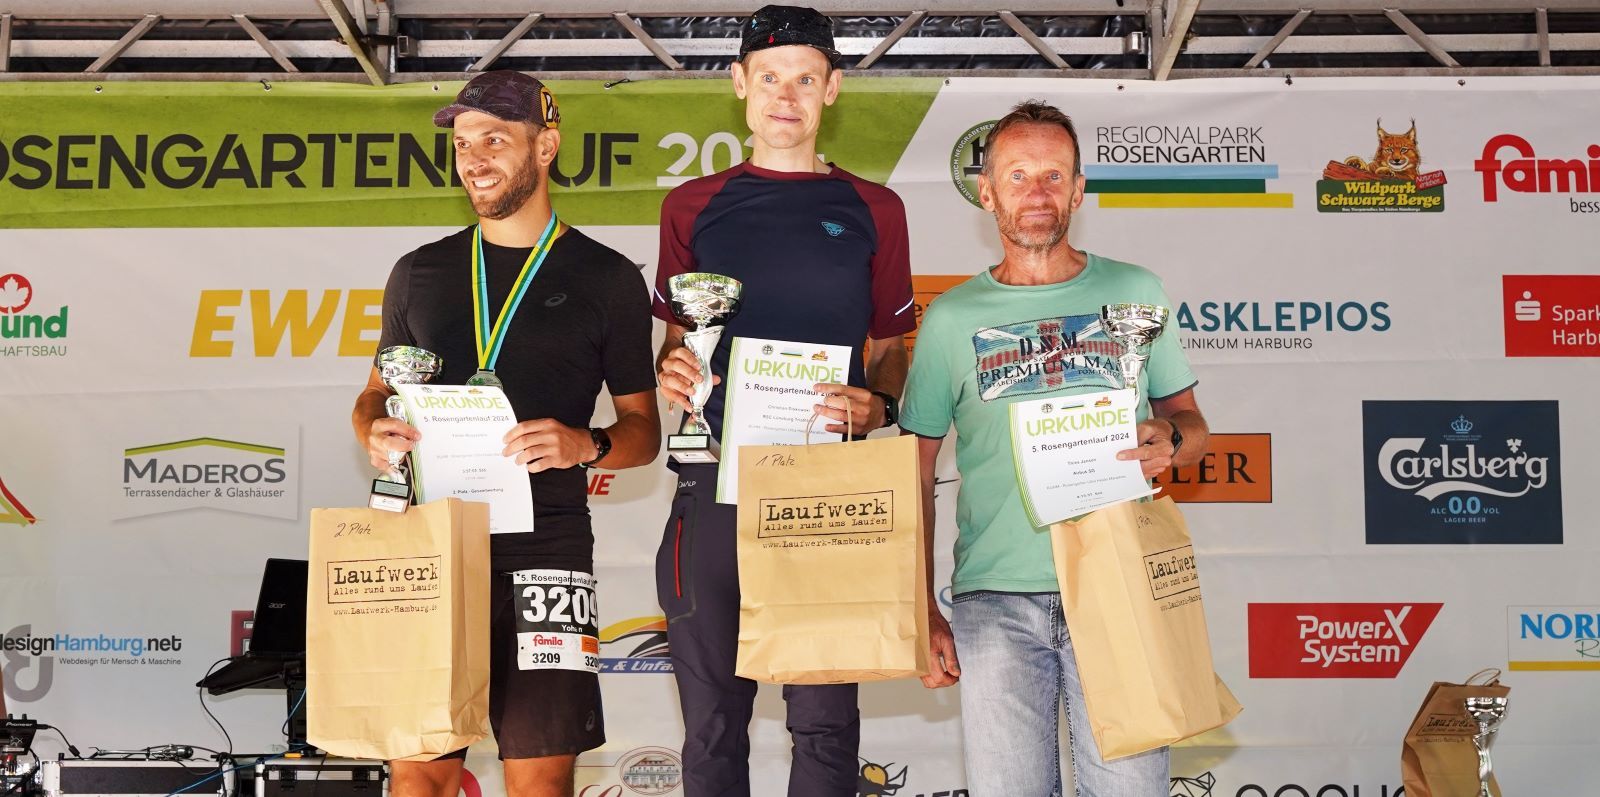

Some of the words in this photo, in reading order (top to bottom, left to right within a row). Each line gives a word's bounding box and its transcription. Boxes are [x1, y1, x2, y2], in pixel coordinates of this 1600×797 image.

[1096, 126, 1264, 144] REGIONALPARK
[1096, 145, 1265, 163] ROSENGARTEN
[1344, 182, 1416, 196] Wildpark
[1320, 194, 1396, 206] Schwarze
[1397, 194, 1441, 208] Berge
[189, 289, 384, 357] EWE
[1176, 301, 1391, 332] ASKLEPIOS
[1244, 338, 1313, 349] HARBURG
[743, 357, 843, 384] URKUNDE
[980, 357, 1075, 384] PREMIUM
[414, 396, 506, 409] URKUNDE
[1026, 408, 1130, 437] URKUNDE
[1041, 436, 1109, 452] Rosengartenlauf
[1110, 432, 1130, 442] 2024
[123, 459, 286, 484] MADEROS
[1152, 453, 1256, 484] LER
[1378, 437, 1549, 490] Carlsberg
[124, 487, 211, 498] Terrassendächer
[214, 488, 222, 498] &
[226, 487, 285, 498] Glashäuser
[766, 498, 888, 521] Laufwerk
[1449, 496, 1481, 514] 0.0
[764, 523, 794, 531] Alles
[800, 521, 823, 530] rund
[852, 518, 888, 526] Laufen
[763, 536, 886, 549] www.Laufwerk-Hamburg.de
[333, 563, 439, 585] Laufwerk
[521, 574, 529, 582] 5.
[334, 587, 359, 596] Alles
[364, 585, 385, 593] rund
[1296, 606, 1413, 646] PowerX
[1520, 613, 1600, 639] NOR
[0, 634, 182, 656] esignHamburg.net
[533, 634, 563, 647] famila
[59, 657, 98, 666] Webdesign
[100, 657, 109, 665] für
[111, 657, 140, 665] Mensch
[148, 657, 181, 665] Maschine
[532, 653, 560, 664] 3209
[1300, 639, 1400, 668] System
[613, 660, 627, 671] &
[631, 660, 674, 671] Unfa
